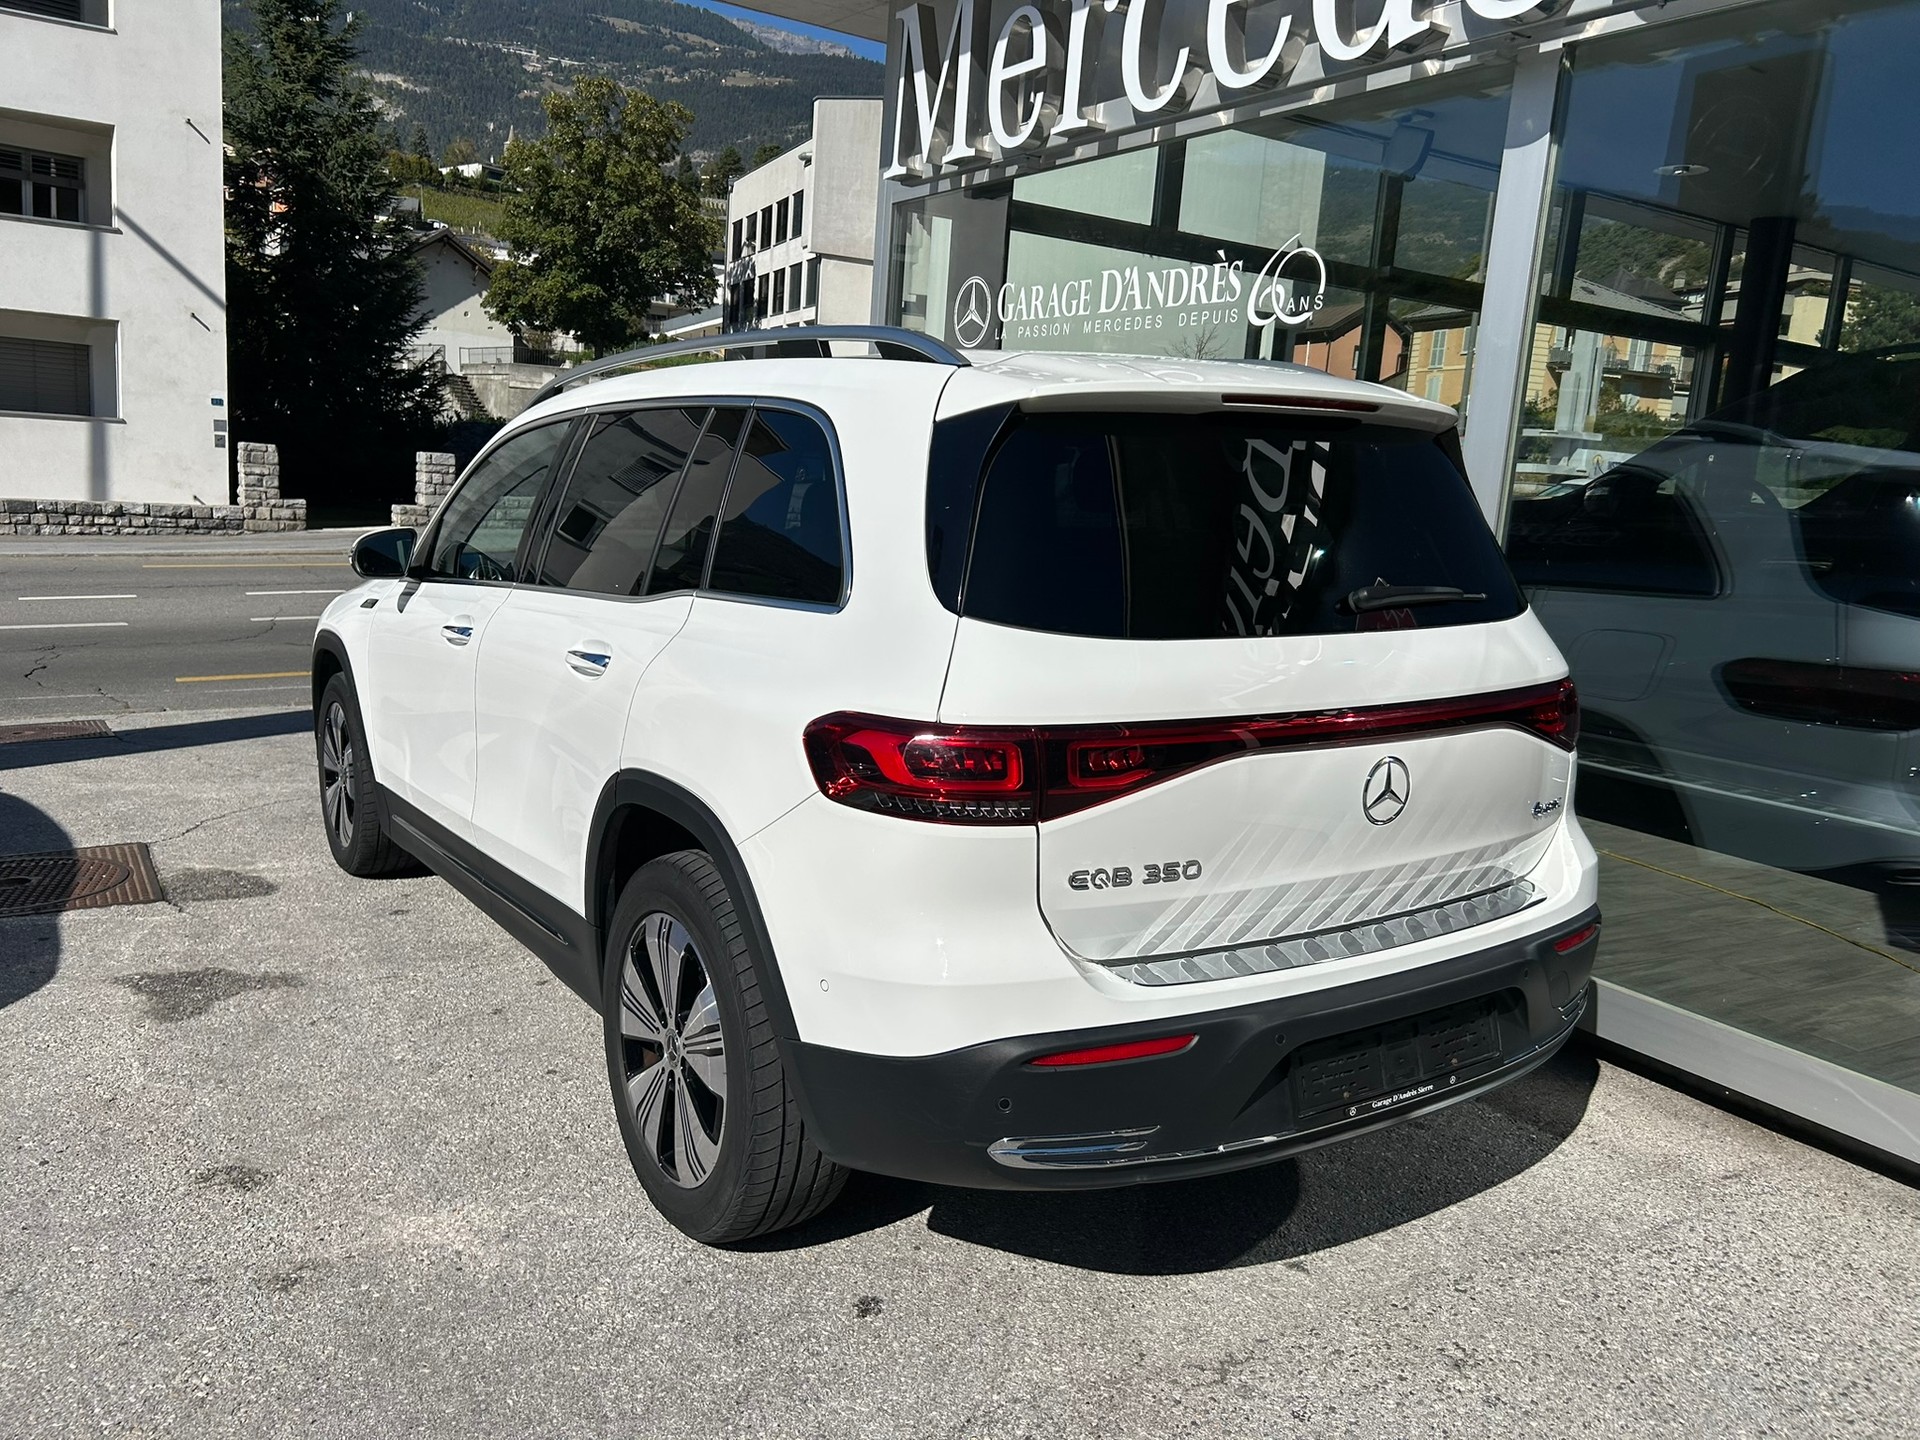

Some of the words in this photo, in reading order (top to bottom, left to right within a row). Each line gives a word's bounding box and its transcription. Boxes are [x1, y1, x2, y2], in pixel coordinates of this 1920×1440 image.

[997, 279, 1093, 323] GARAGE
[1097, 250, 1244, 314] D'ANDRÈS
[994, 327, 1008, 341] LA
[1017, 322, 1071, 339] PASSION
[1083, 314, 1163, 335] MERCEDES
[1178, 308, 1239, 327] DEPUIS
[1285, 294, 1325, 313] ANS
[1067, 866, 1133, 891] EQB
[1141, 859, 1203, 885] 350
[1371, 1097, 1392, 1109] Garage
